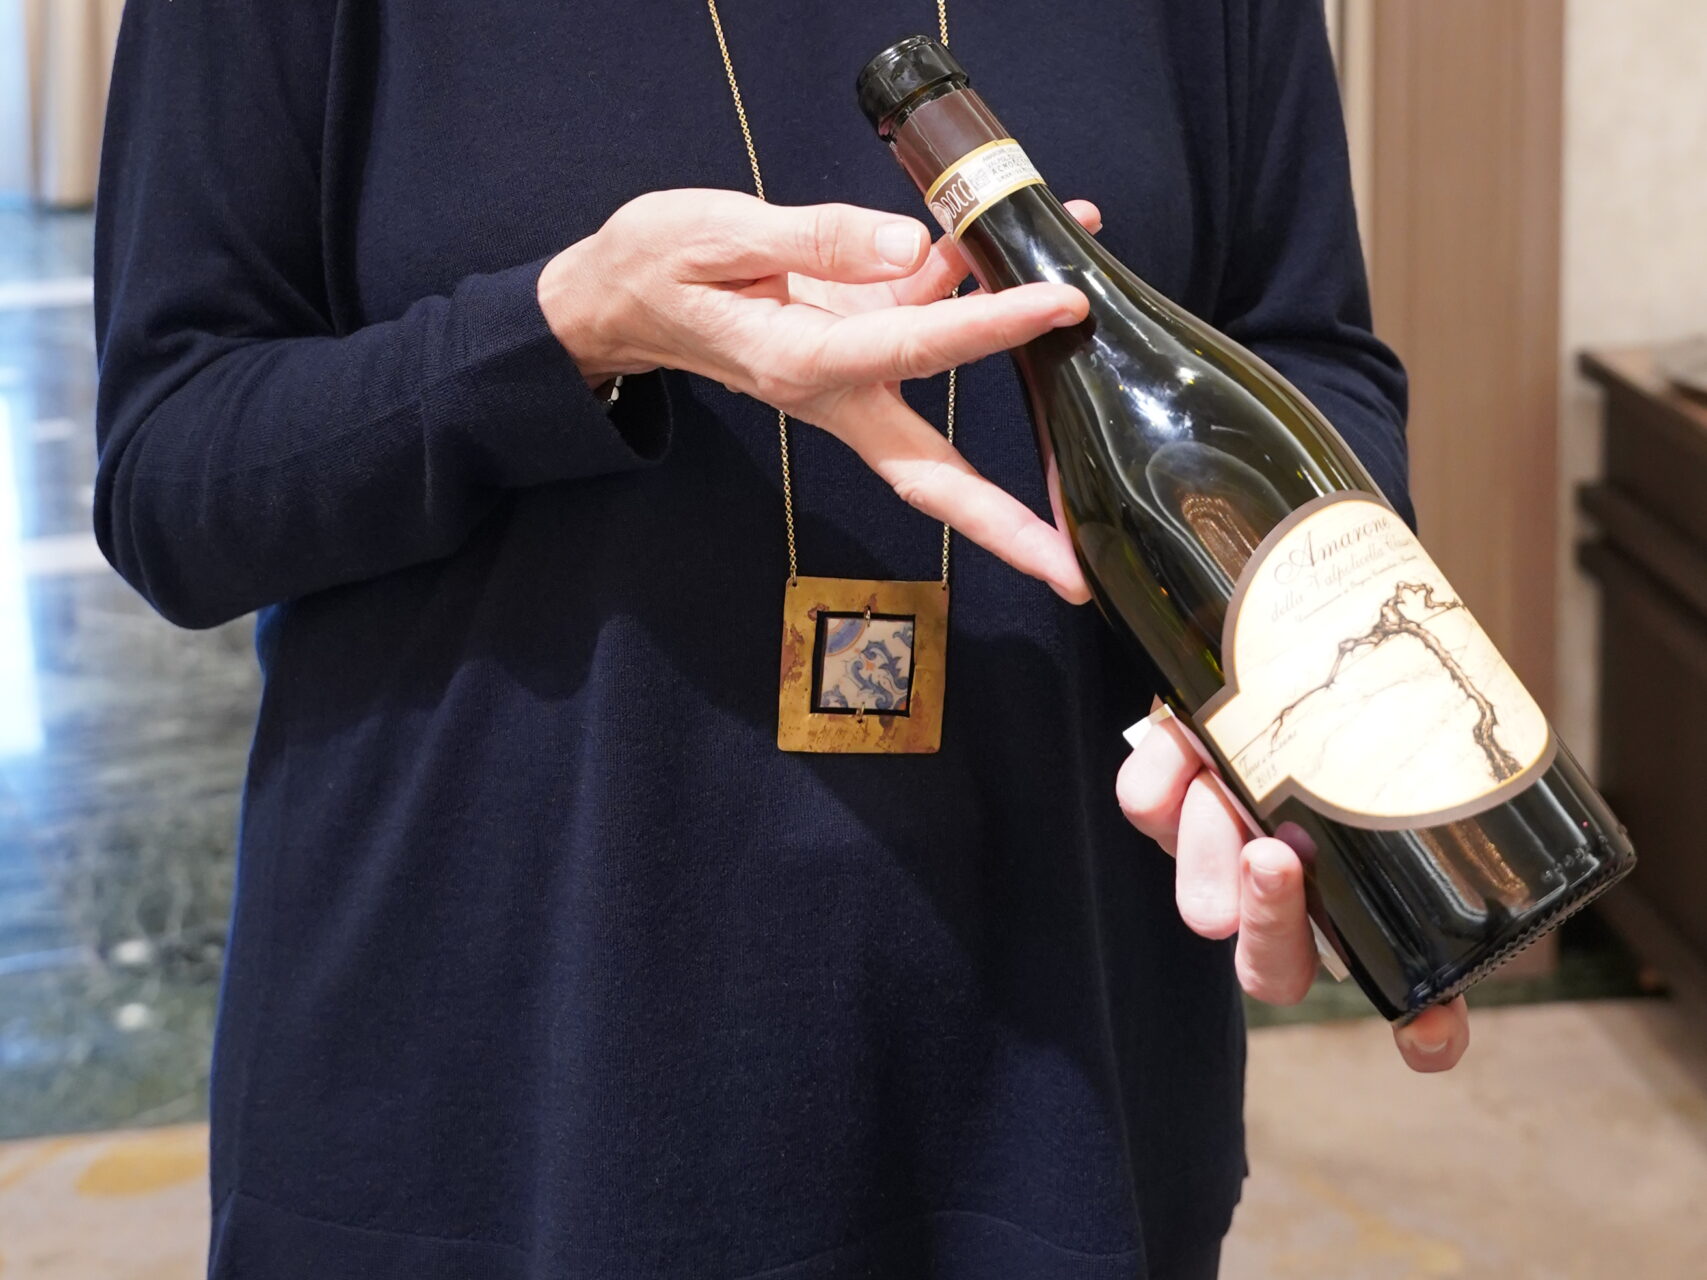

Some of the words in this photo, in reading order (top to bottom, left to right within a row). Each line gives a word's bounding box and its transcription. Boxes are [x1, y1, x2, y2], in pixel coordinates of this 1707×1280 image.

[941, 178, 976, 220] DOCG
[1271, 590, 1305, 623] della
[1308, 540, 1385, 591] Valpolicella
[1274, 517, 1391, 585] Amarone
